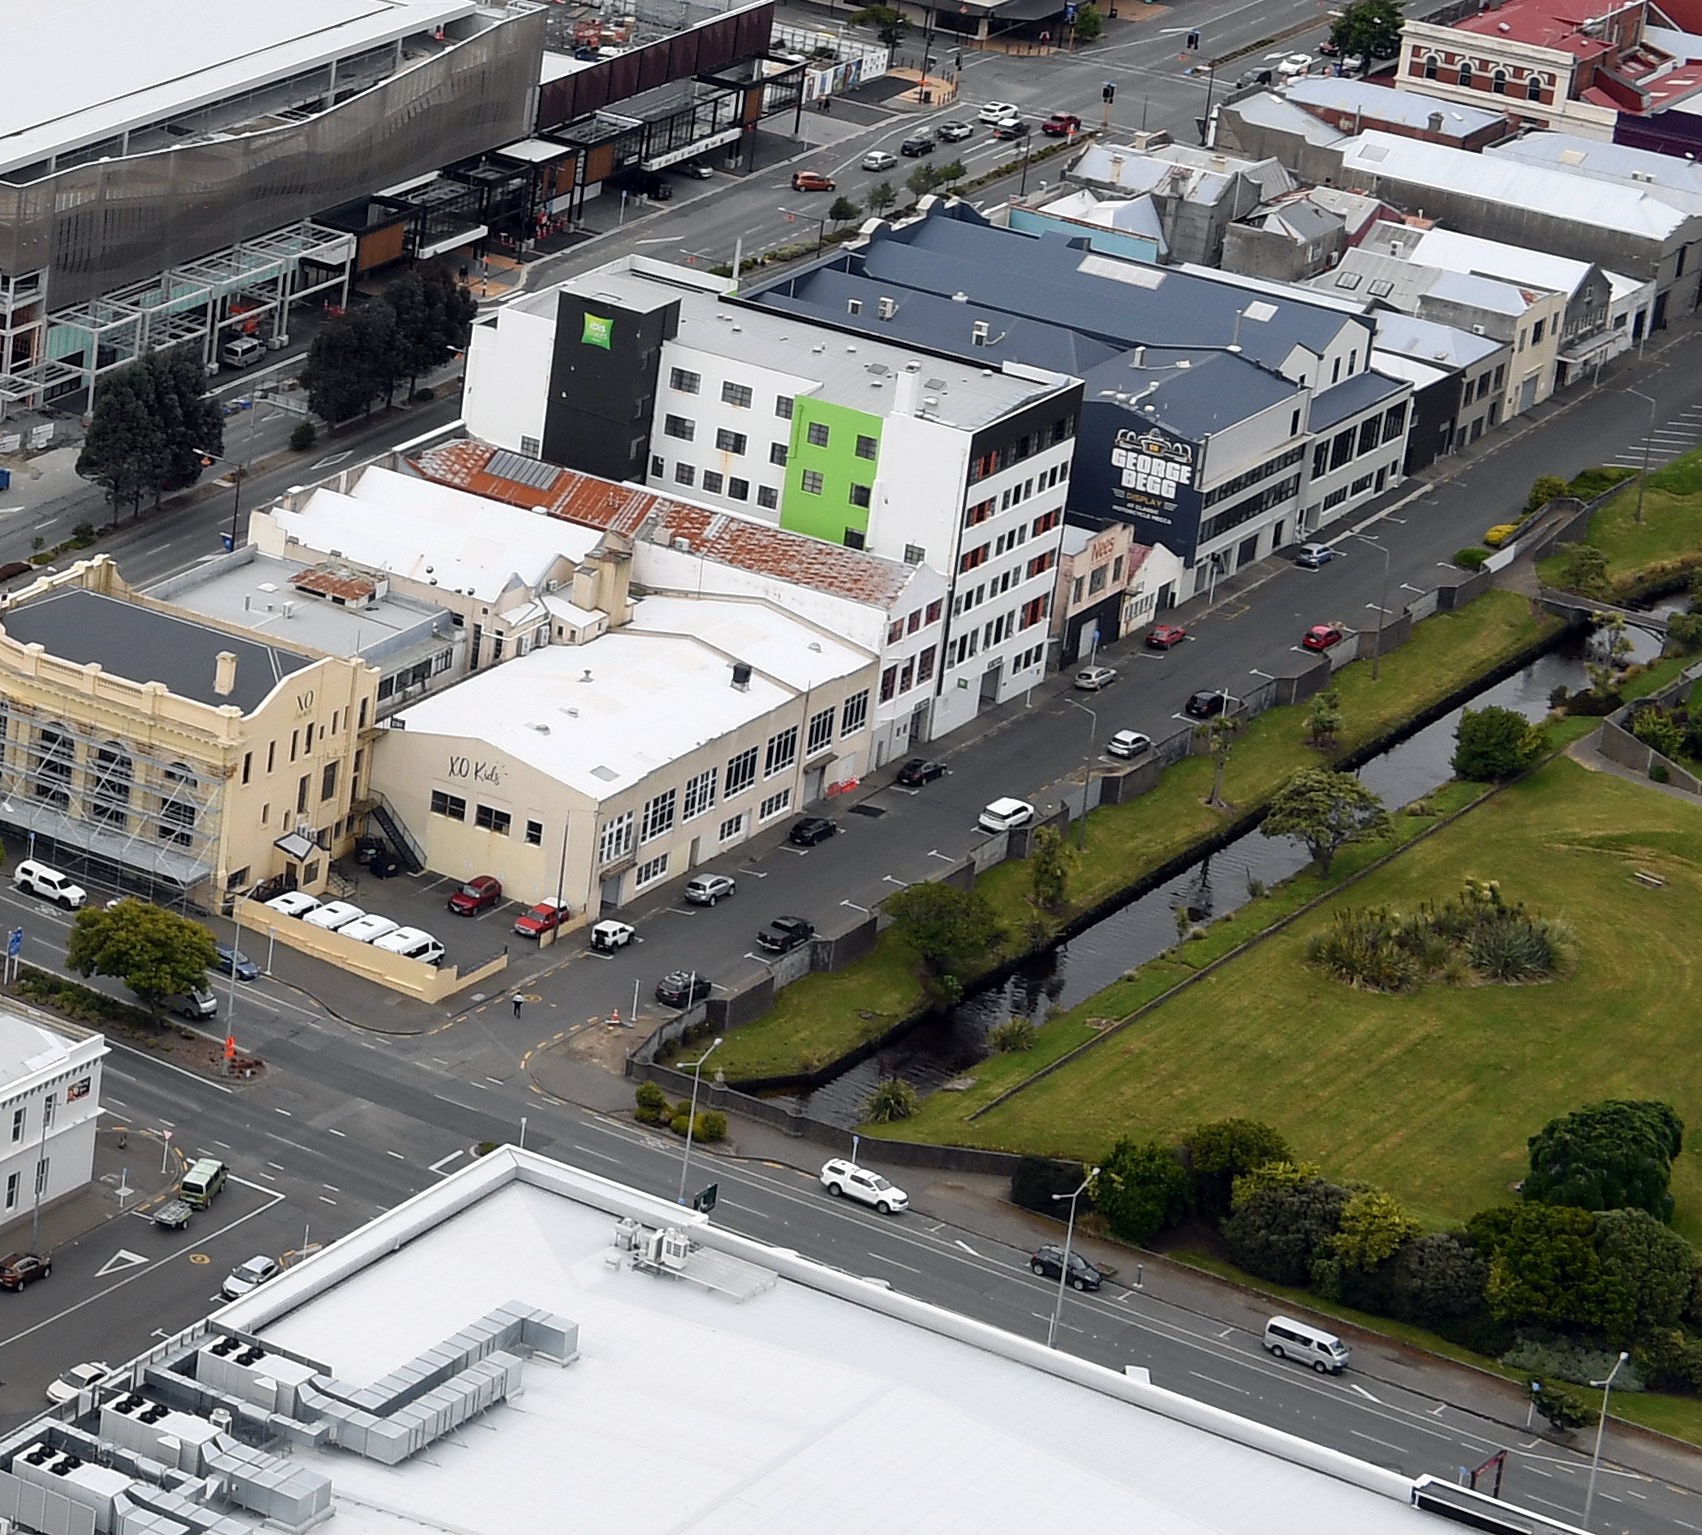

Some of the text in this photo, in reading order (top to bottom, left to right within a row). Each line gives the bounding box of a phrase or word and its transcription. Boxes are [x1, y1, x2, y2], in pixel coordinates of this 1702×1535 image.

[589, 322, 605, 334] ibis
[1111, 446, 1193, 485] GEORGE
[1121, 468, 1177, 500] BEGG
[1125, 493, 1162, 508] DISPLAY
[1111, 505, 1173, 526] MOTORCYCLE MECCA
[448, 756, 500, 786] XO Kids
